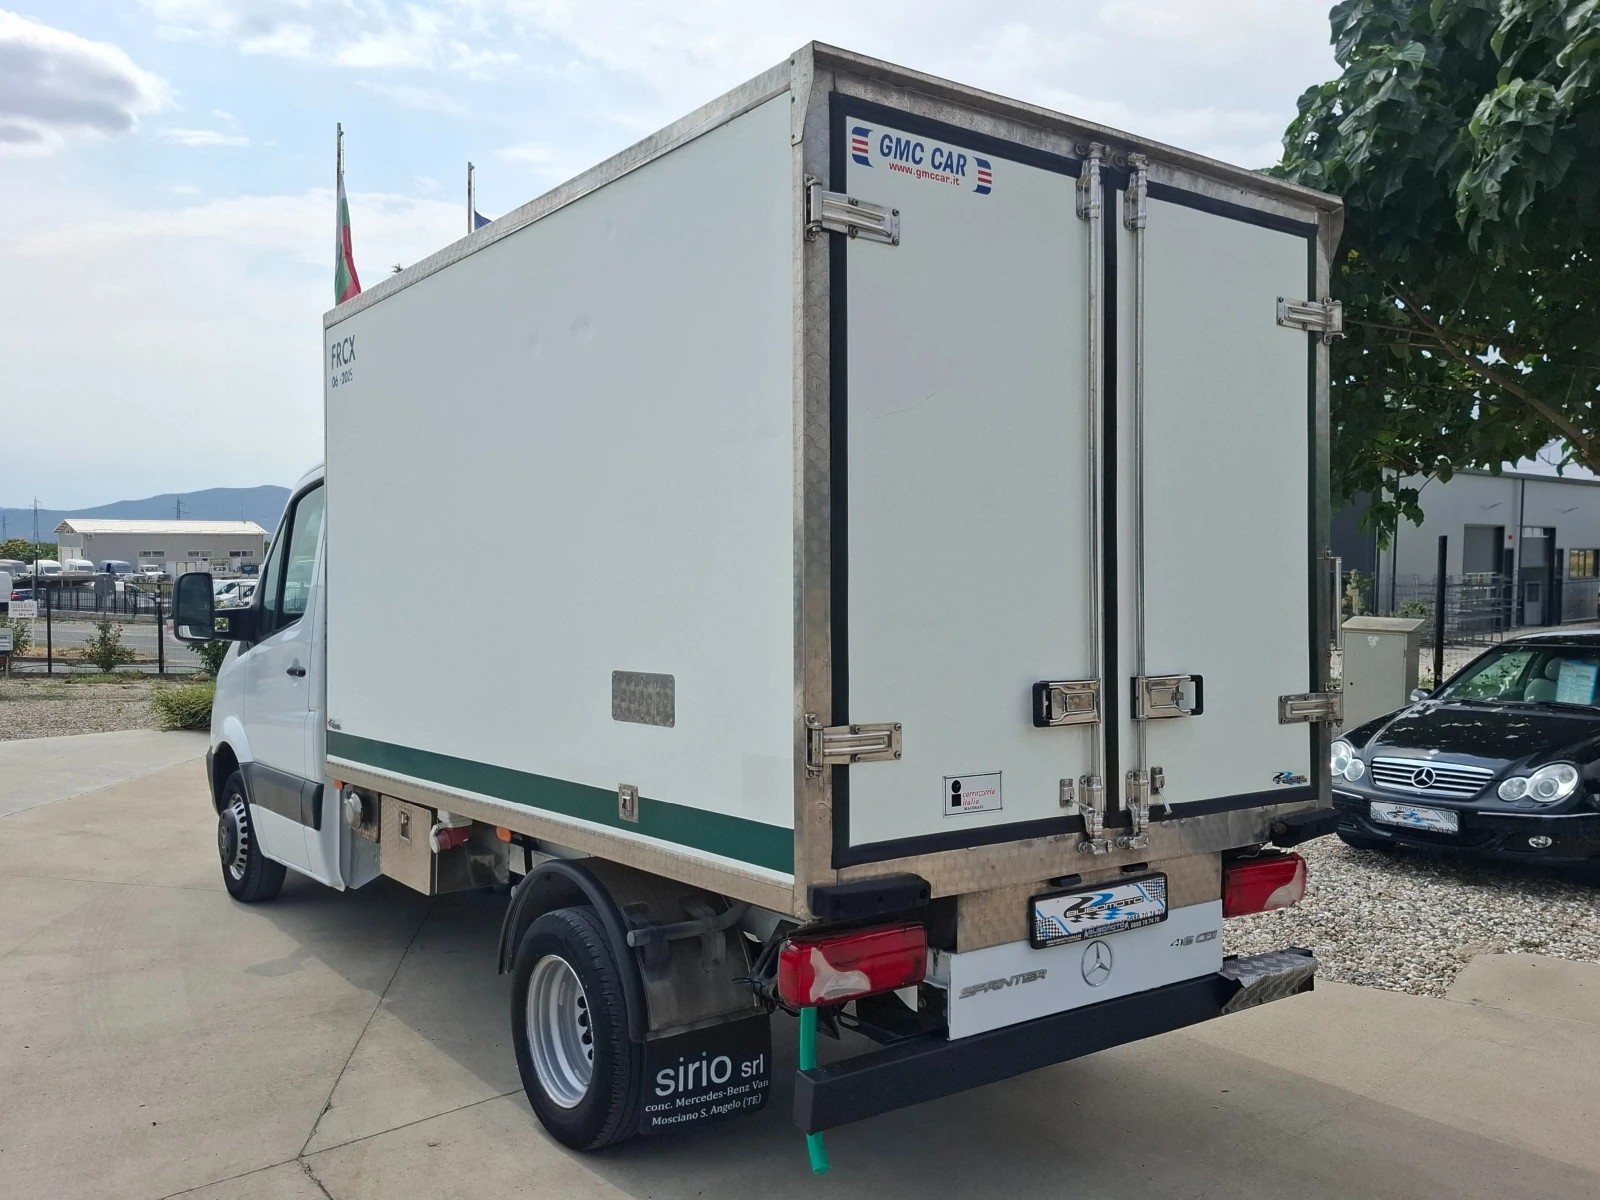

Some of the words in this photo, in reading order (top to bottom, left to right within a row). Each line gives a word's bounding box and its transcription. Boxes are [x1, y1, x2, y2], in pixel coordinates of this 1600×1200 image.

[880, 134, 924, 165] GMC
[931, 148, 967, 176] CAR
[889, 162, 960, 186] www.gmccar.it
[331, 334, 356, 370] FRCX
[962, 788, 996, 798] carrozzeria
[962, 798, 979, 806] italia
[959, 969, 1048, 1000] SPRINTER
[655, 1051, 732, 1096] sirio
[741, 1053, 764, 1077] srl
[645, 1102, 673, 1112] conc.
[675, 1085, 750, 1107] Mercedes-Benz
[752, 1079, 769, 1090] Van
[652, 1111, 698, 1126] Mosciano
[700, 1108, 708, 1118] S.
[710, 1099, 741, 1116] Angelo
[742, 1093, 762, 1108] (TE)
